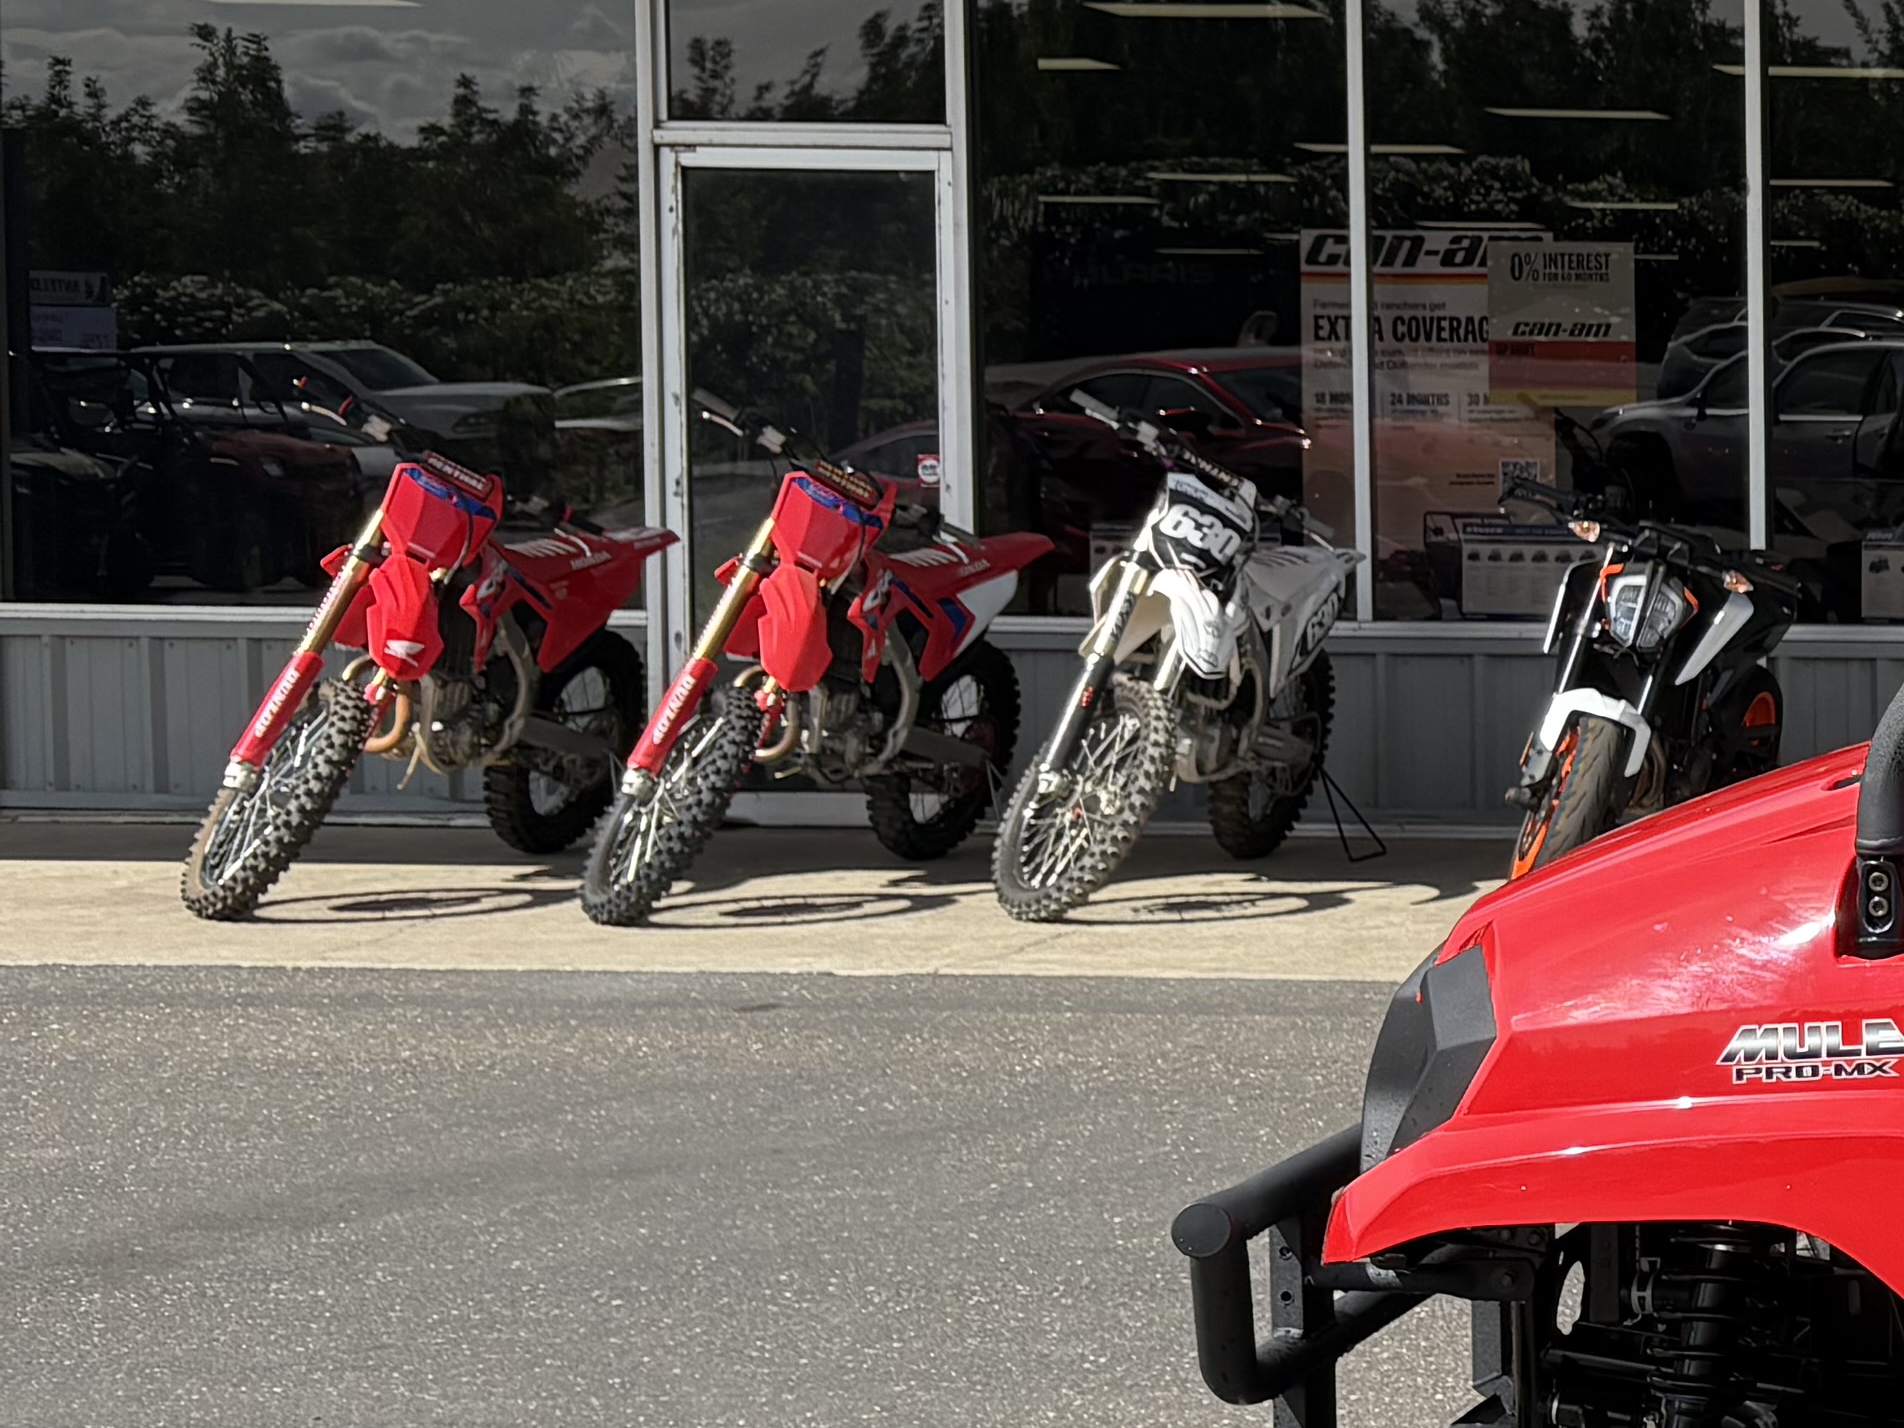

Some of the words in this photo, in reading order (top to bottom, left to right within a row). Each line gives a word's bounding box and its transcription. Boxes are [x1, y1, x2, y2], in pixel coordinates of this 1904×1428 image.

[1510, 252, 1540, 282] 0%
[1543, 252, 1613, 271] INTEREST
[1574, 272, 1610, 284] MONTHS
[1313, 314, 1385, 343] EXTA
[1391, 315, 1489, 345] COVERAG
[1512, 320, 1612, 338] can-am
[1390, 392, 1404, 406] 24
[1158, 502, 1243, 566] 630
[1732, 1058, 1900, 1085] PRO-MX
